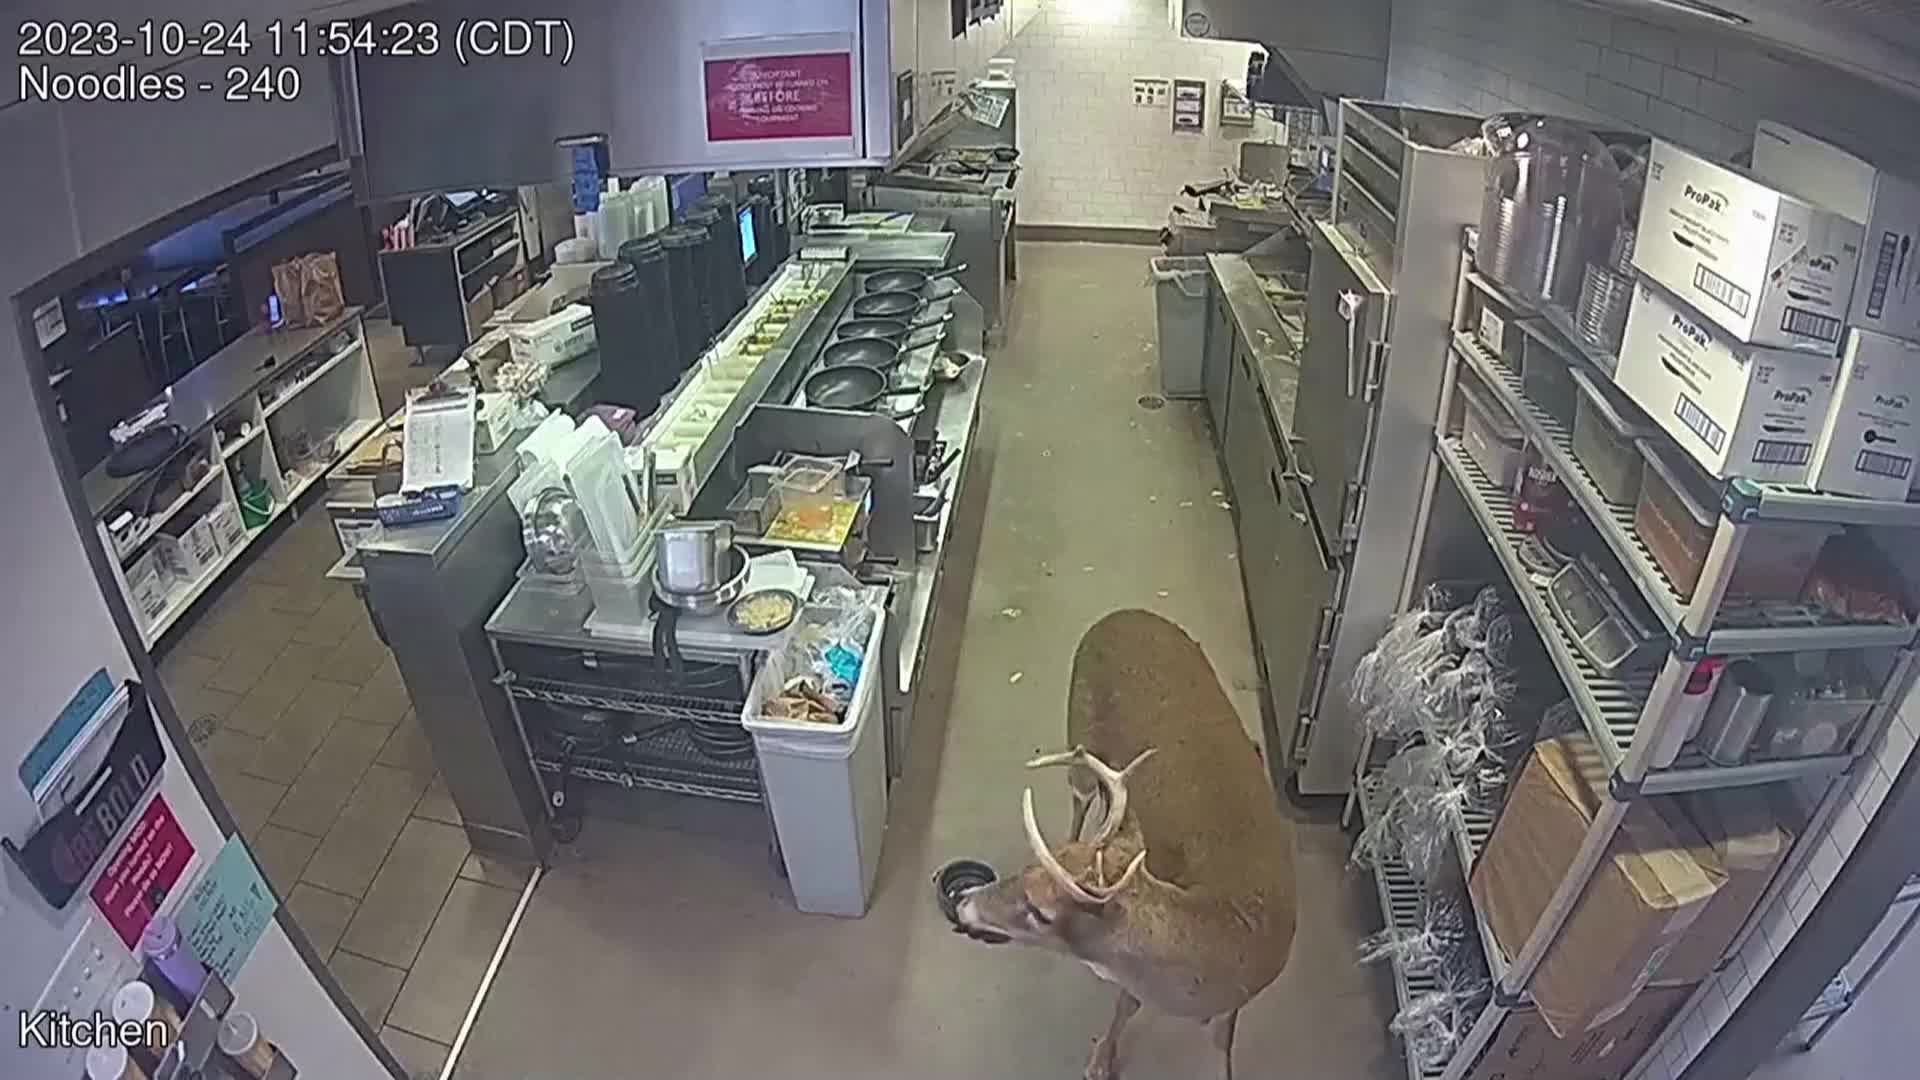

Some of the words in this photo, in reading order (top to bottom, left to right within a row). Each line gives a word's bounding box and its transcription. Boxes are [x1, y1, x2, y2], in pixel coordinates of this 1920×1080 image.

[1684, 183, 1723, 214] ProPak
[1671, 313, 1707, 348] ProPak
[1774, 388, 1807, 404] ProPak
[1873, 394, 1905, 409] ProPak
